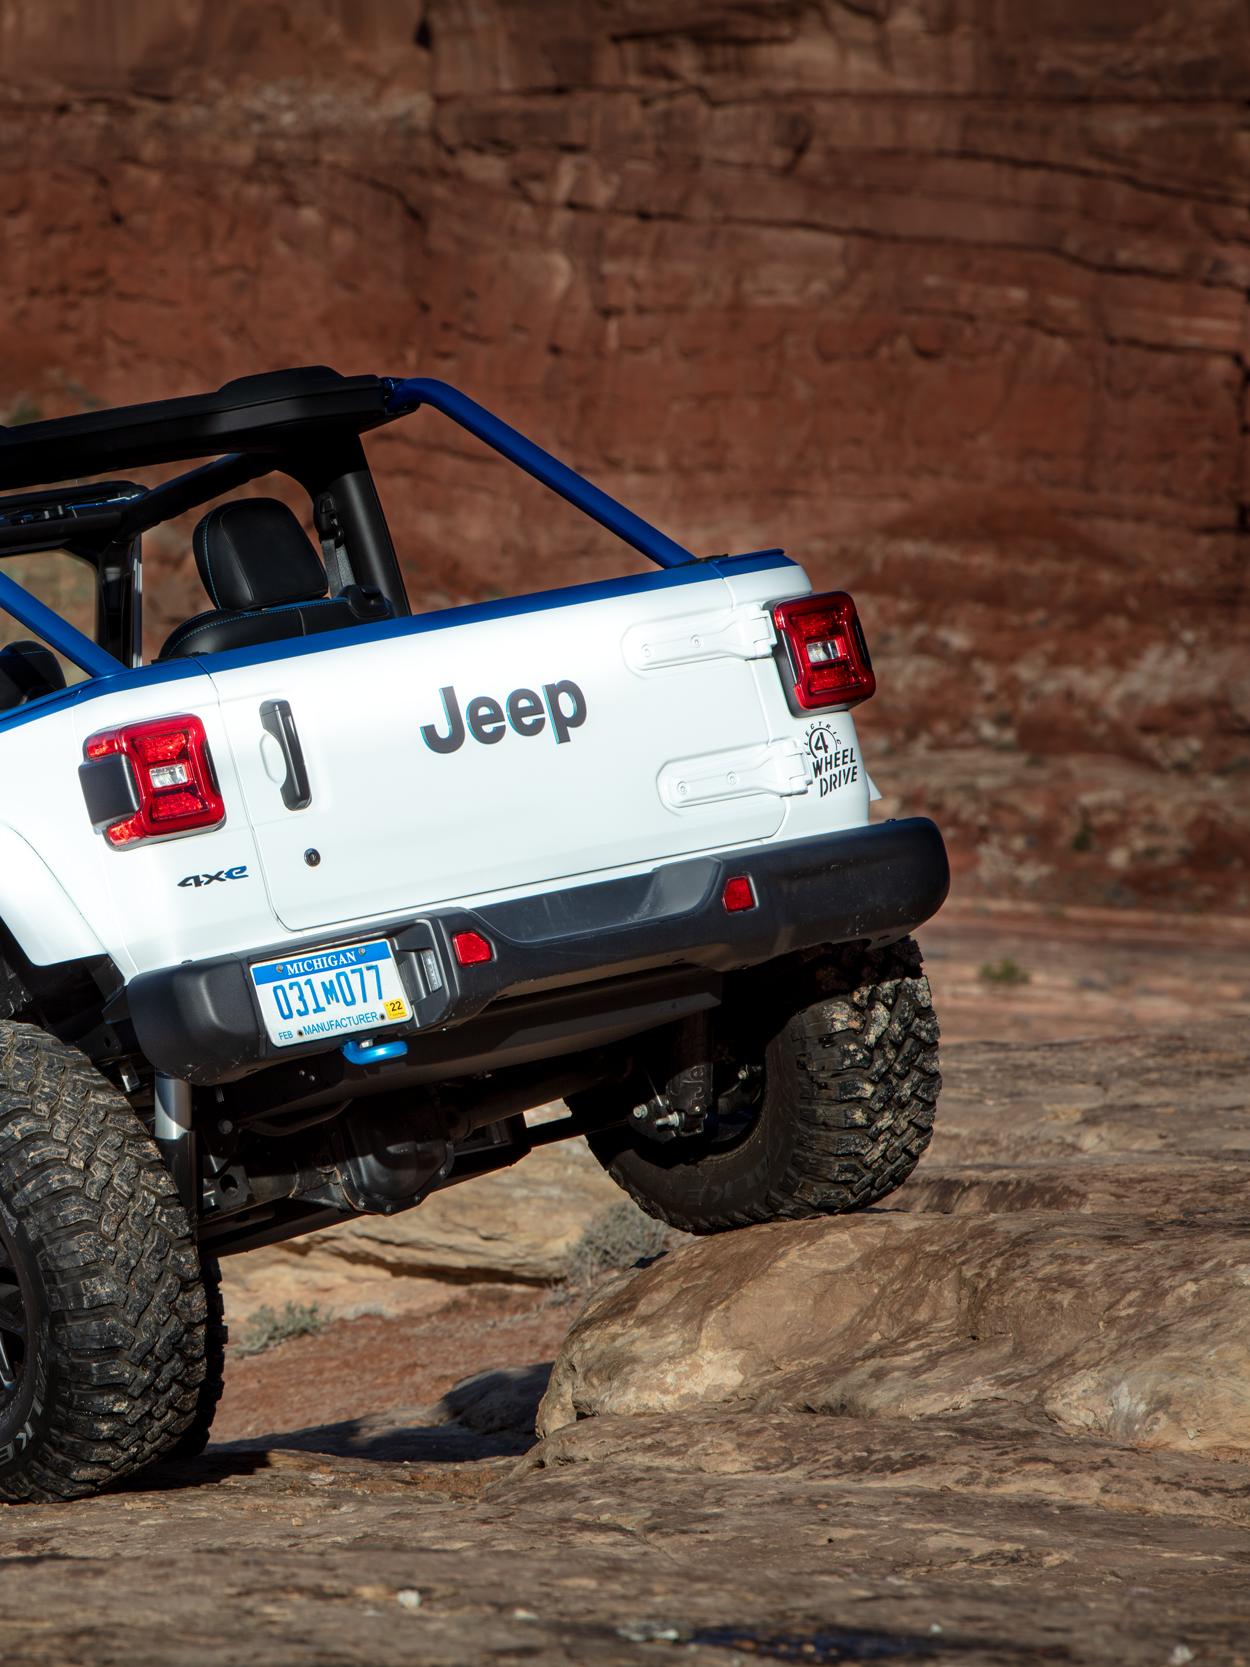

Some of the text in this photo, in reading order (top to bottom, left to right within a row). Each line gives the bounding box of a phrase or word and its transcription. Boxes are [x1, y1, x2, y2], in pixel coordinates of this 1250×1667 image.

[420, 679, 588, 754] Jeep
[813, 731, 829, 754] 4
[812, 747, 856, 779] WHEEL
[819, 765, 858, 798] DRIVE
[177, 865, 249, 888] 4xe
[286, 951, 357, 976] MICHIGAN
[272, 964, 383, 1020] 031M077
[389, 1000, 403, 1012] 22
[278, 1030, 294, 1040] FEB
[302, 1011, 379, 1036] MANUFACTURER
